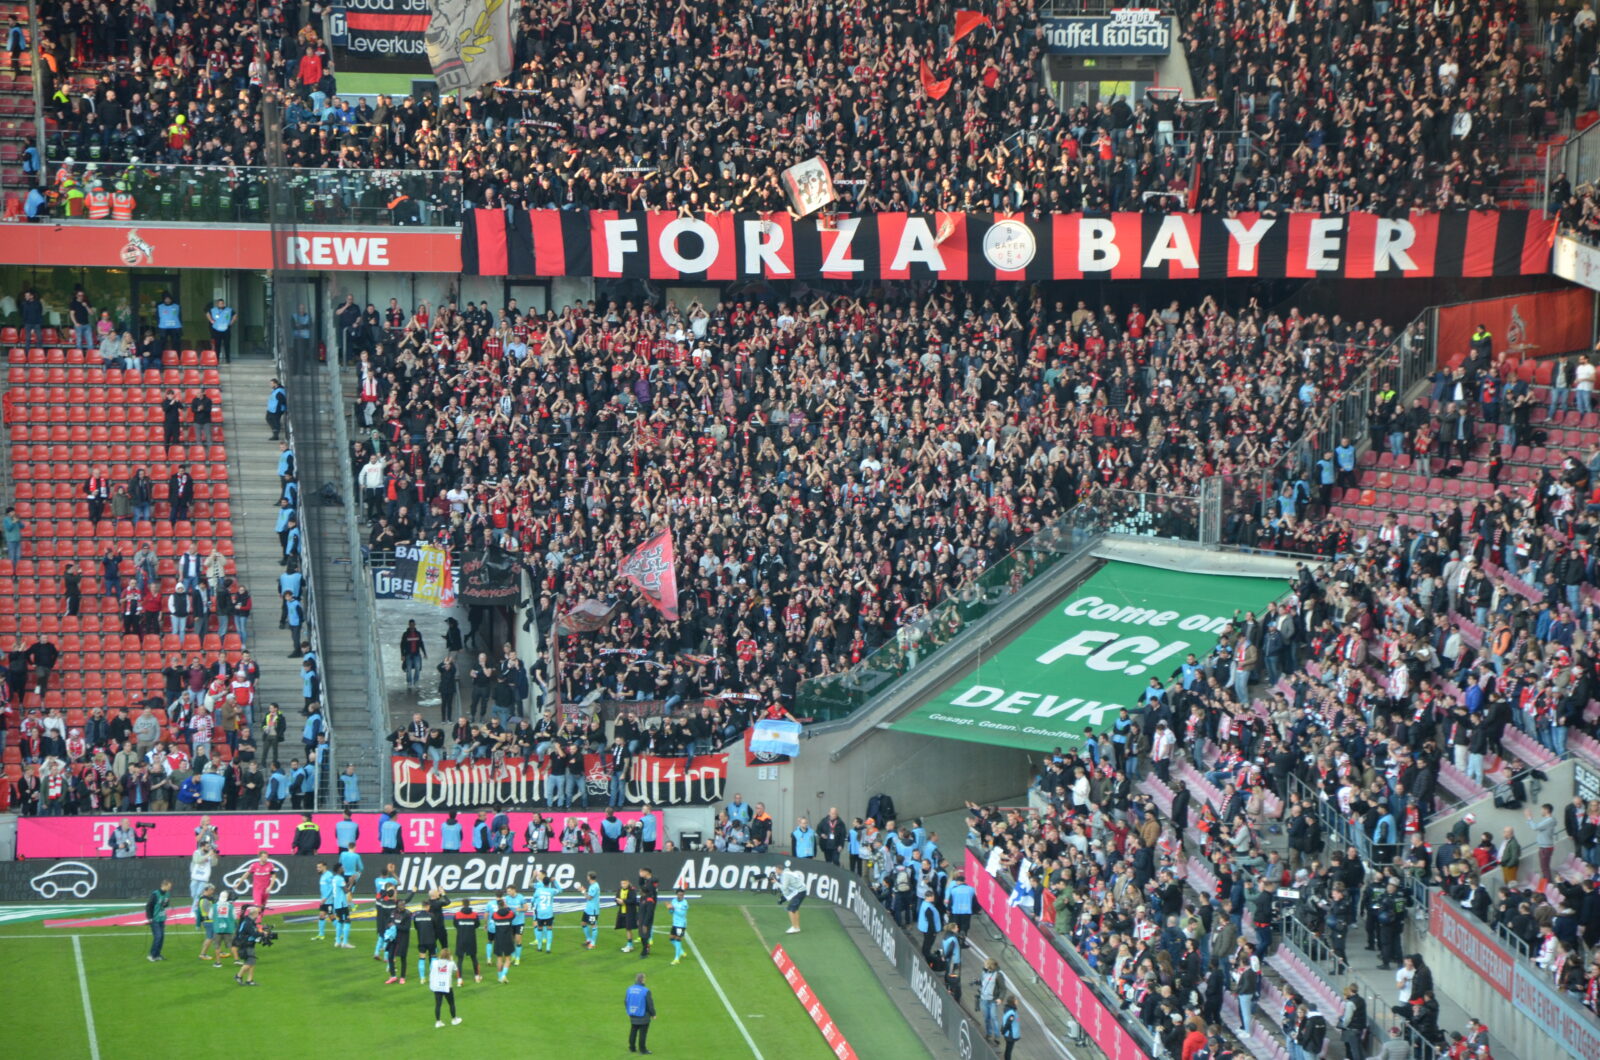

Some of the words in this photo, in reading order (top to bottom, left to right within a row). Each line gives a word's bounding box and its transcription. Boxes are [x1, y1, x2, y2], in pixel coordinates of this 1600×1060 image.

[286, 236, 390, 266] REWE
[604, 217, 947, 274] FORZA
[1078, 216, 1419, 272] BAYER
[395, 546, 444, 565] BAYER
[1064, 596, 1180, 627] Come
[1177, 614, 1233, 635] on
[1035, 630, 1191, 675] FC!
[950, 685, 1126, 726] DEVK
[928, 713, 975, 726] Gesagt.
[978, 720, 1018, 732] Getan.
[1022, 726, 1082, 740] Geholfen.
[254, 820, 279, 848] T
[409, 818, 434, 847] T
